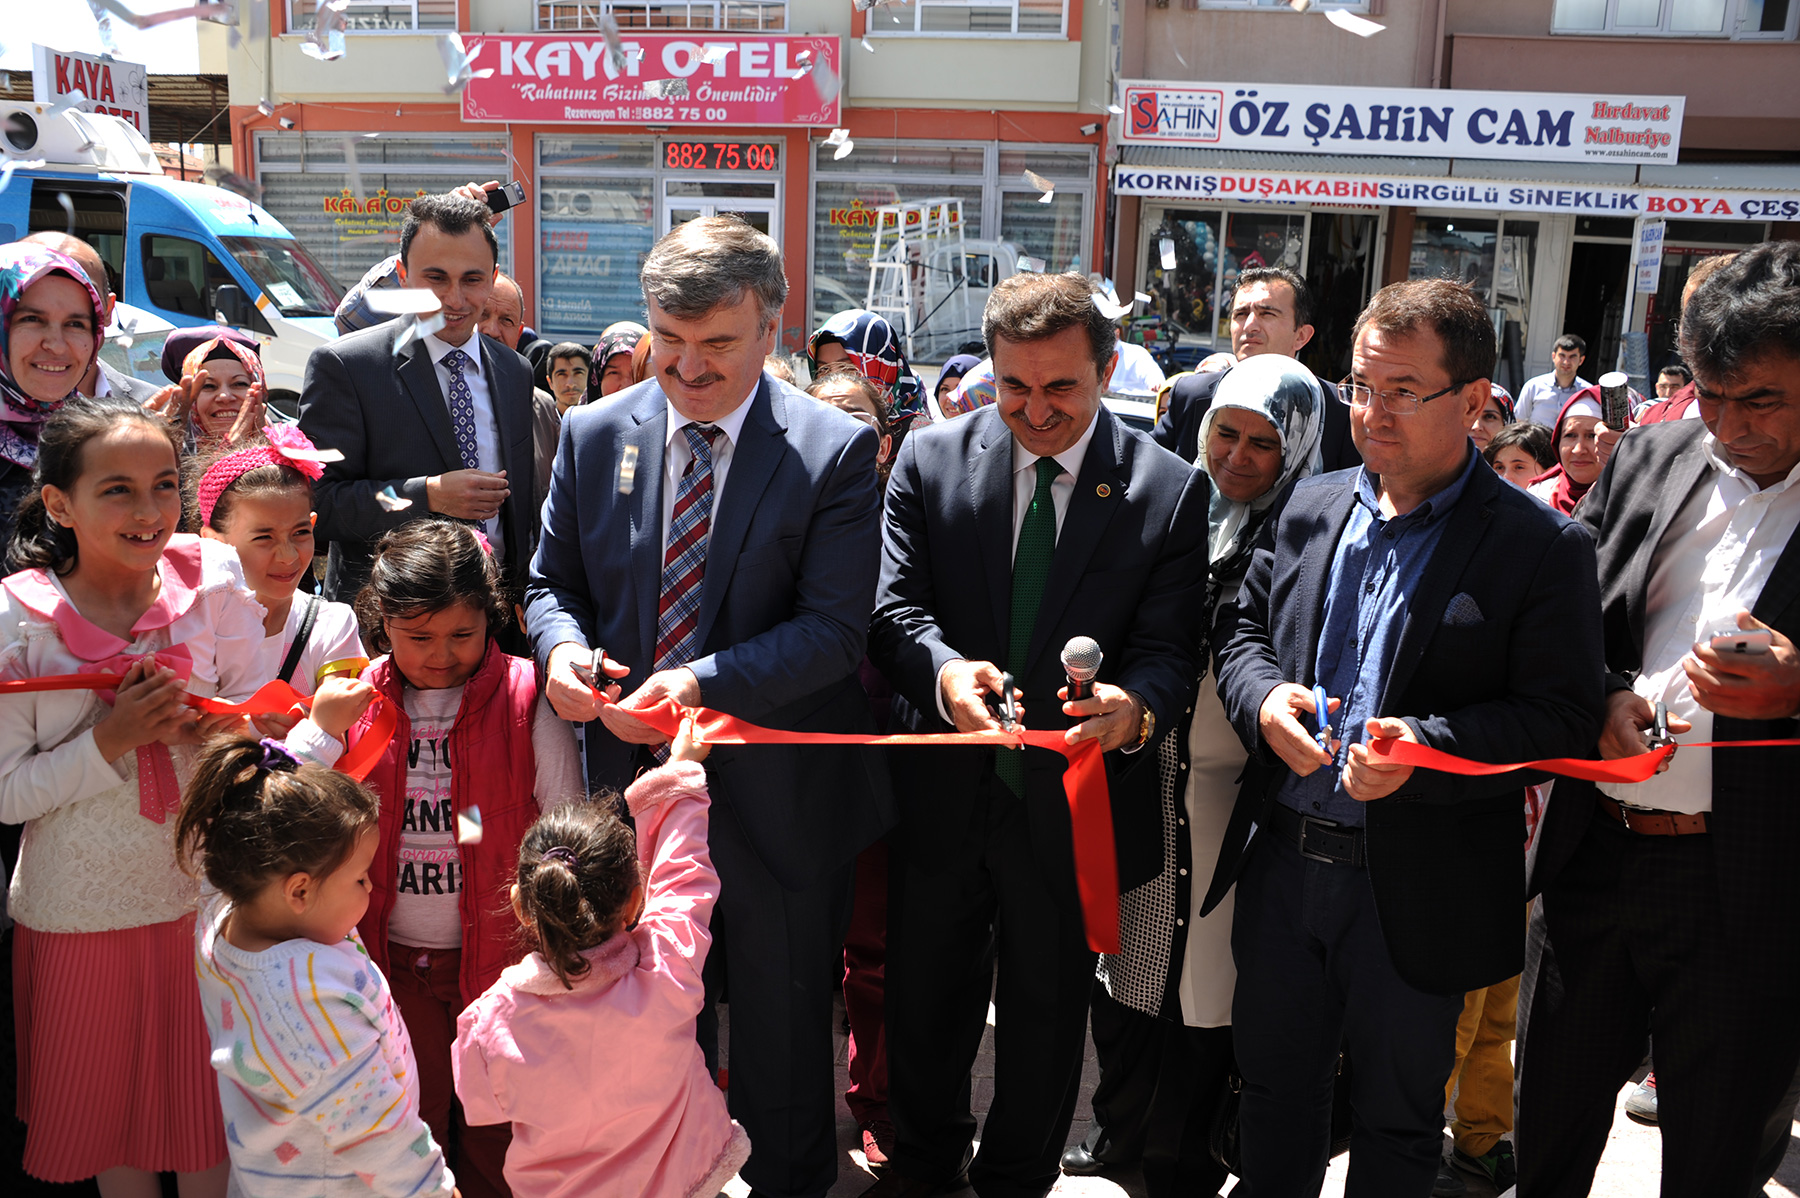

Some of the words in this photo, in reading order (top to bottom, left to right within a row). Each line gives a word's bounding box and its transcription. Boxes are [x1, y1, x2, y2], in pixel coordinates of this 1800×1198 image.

[501, 41, 640, 81] KAYA
[661, 41, 805, 78] OTEL
[54, 54, 116, 103] KAYA
[564, 106, 615, 121] Rezervasyon
[643, 107, 674, 120] 882
[679, 108, 700, 120] 75
[705, 108, 727, 120] 00
[1229, 89, 1290, 137] ÖZ
[1467, 107, 1575, 147] CAM
[1584, 126, 1671, 149] Nalburiye
[667, 143, 707, 169] 882
[713, 143, 740, 169] 75
[746, 144, 775, 170] 00
[1585, 149, 1669, 158] www.ozsahincam.com
[324, 196, 381, 214] KAYA
[386, 197, 414, 214] OT
[1646, 197, 1734, 214] BOYA
[1740, 199, 1800, 220] ÇEŞ
[396, 861, 463, 895] ARI
